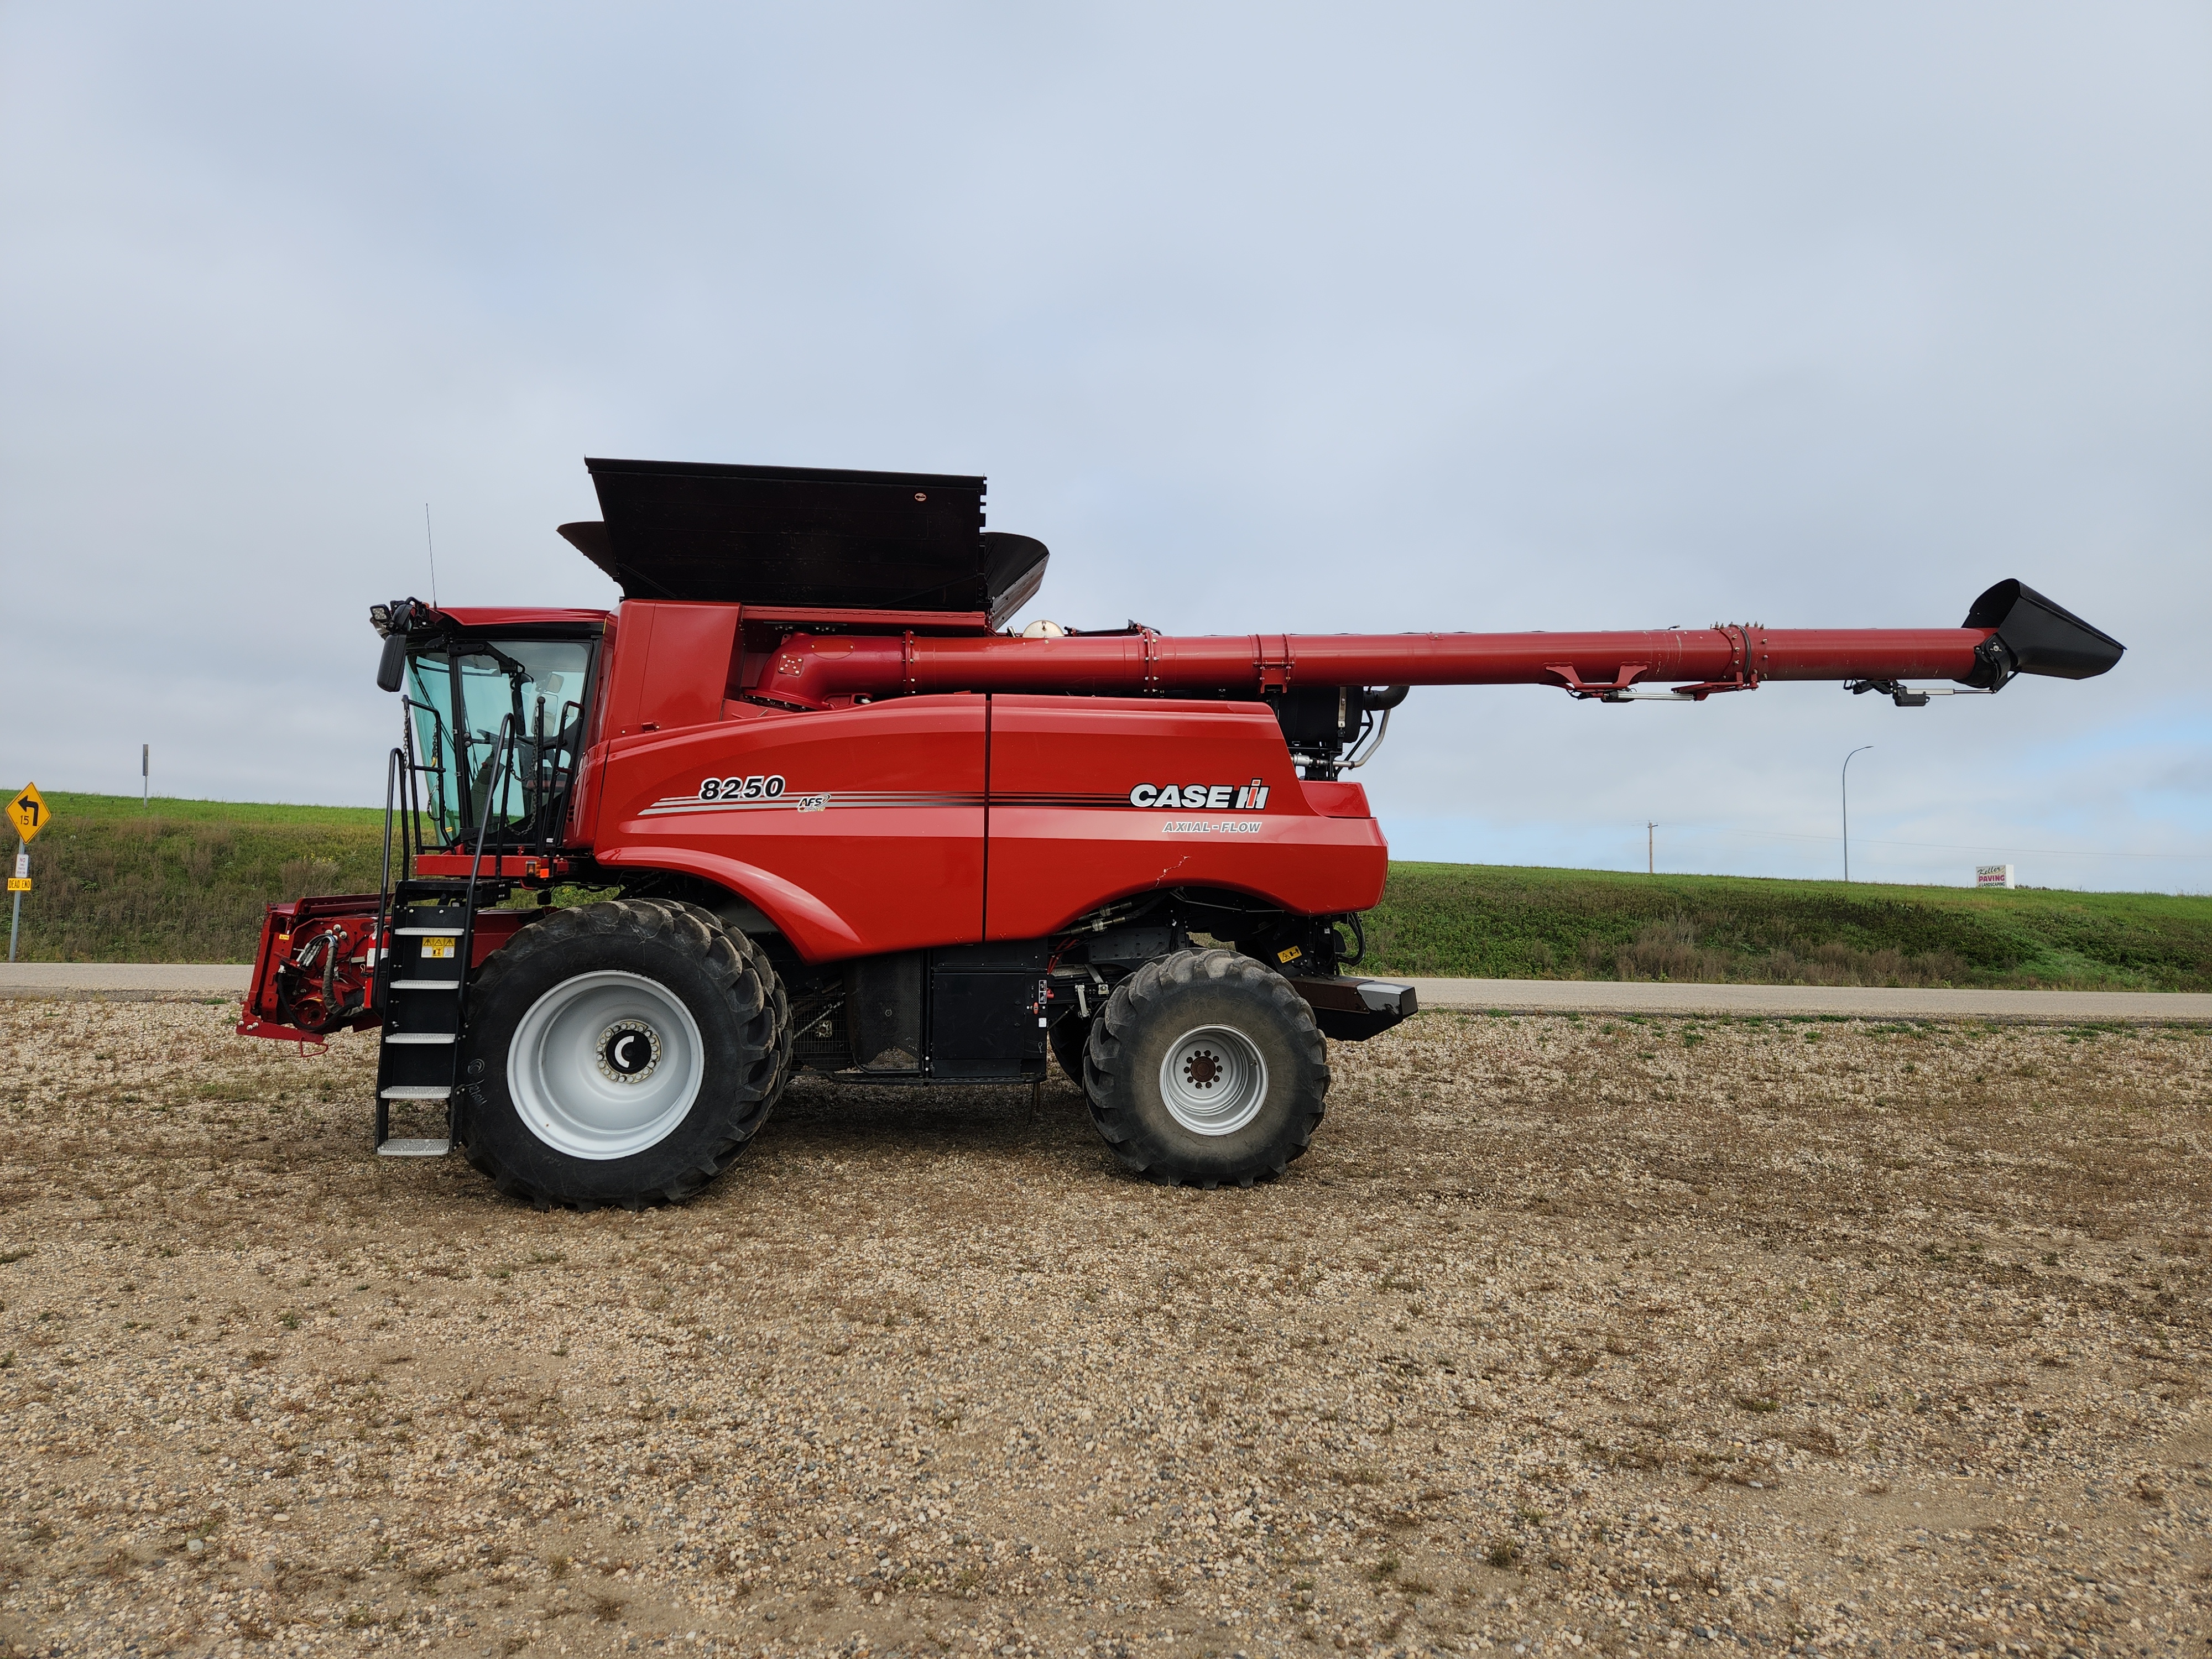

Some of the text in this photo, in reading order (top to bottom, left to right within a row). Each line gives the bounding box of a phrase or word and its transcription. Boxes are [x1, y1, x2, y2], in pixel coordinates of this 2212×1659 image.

[699, 775, 785, 801] 8250
[1130, 784, 1234, 808] CASE
[799, 797, 823, 806] AFS
[20, 815, 29, 825] 15
[1162, 822, 1262, 833] AXIAL-FLOW
[1977, 867, 2000, 876] Keller
[9, 880, 19, 888] DEAD
